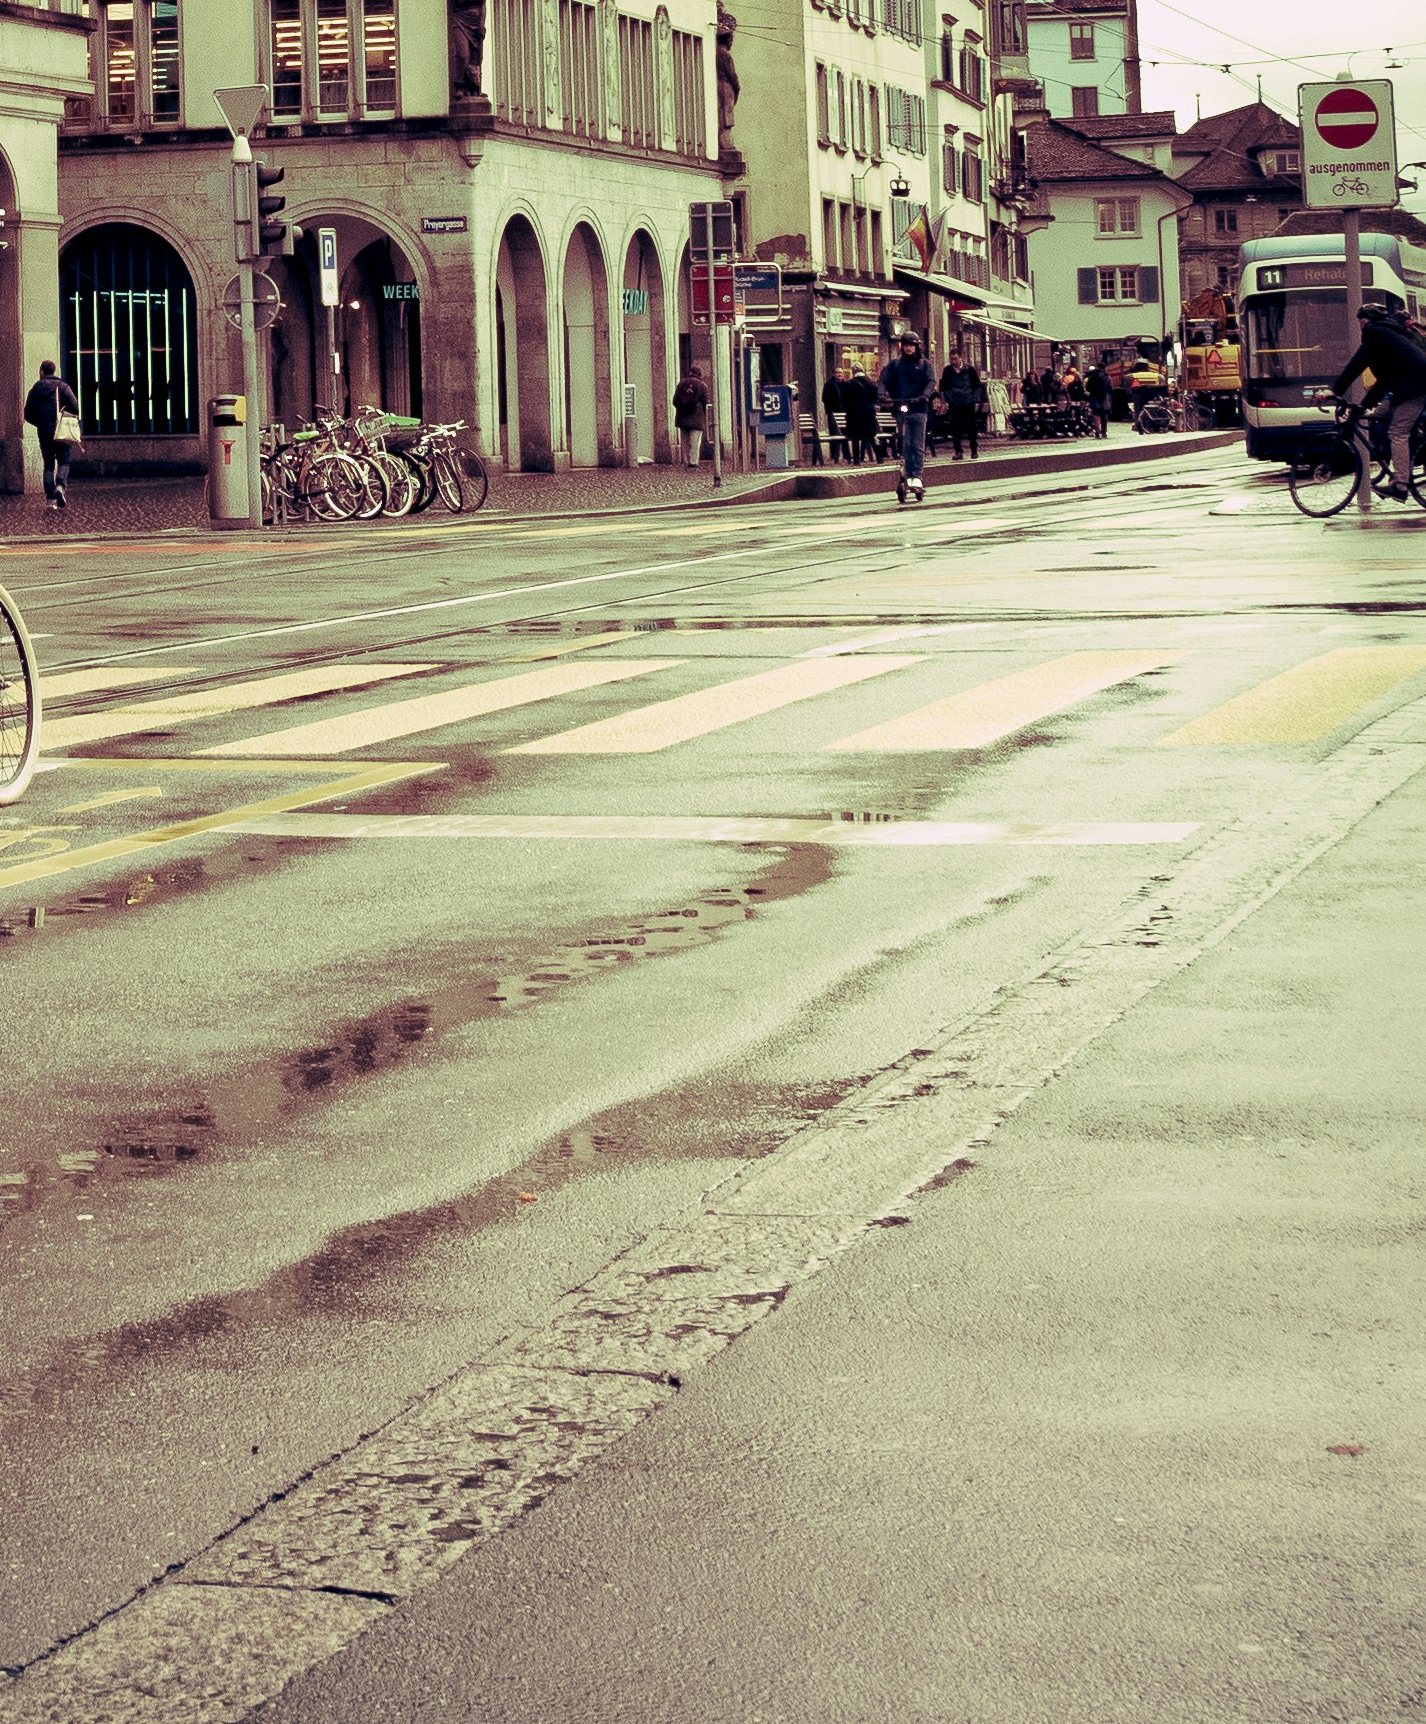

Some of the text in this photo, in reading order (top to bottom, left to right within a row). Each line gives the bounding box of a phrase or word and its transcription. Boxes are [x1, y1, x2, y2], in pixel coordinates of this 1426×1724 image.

[1309, 160, 1391, 177] ausgenommen
[324, 238, 334, 267] P
[1264, 270, 1281, 284] 11
[763, 393, 781, 412] 20
